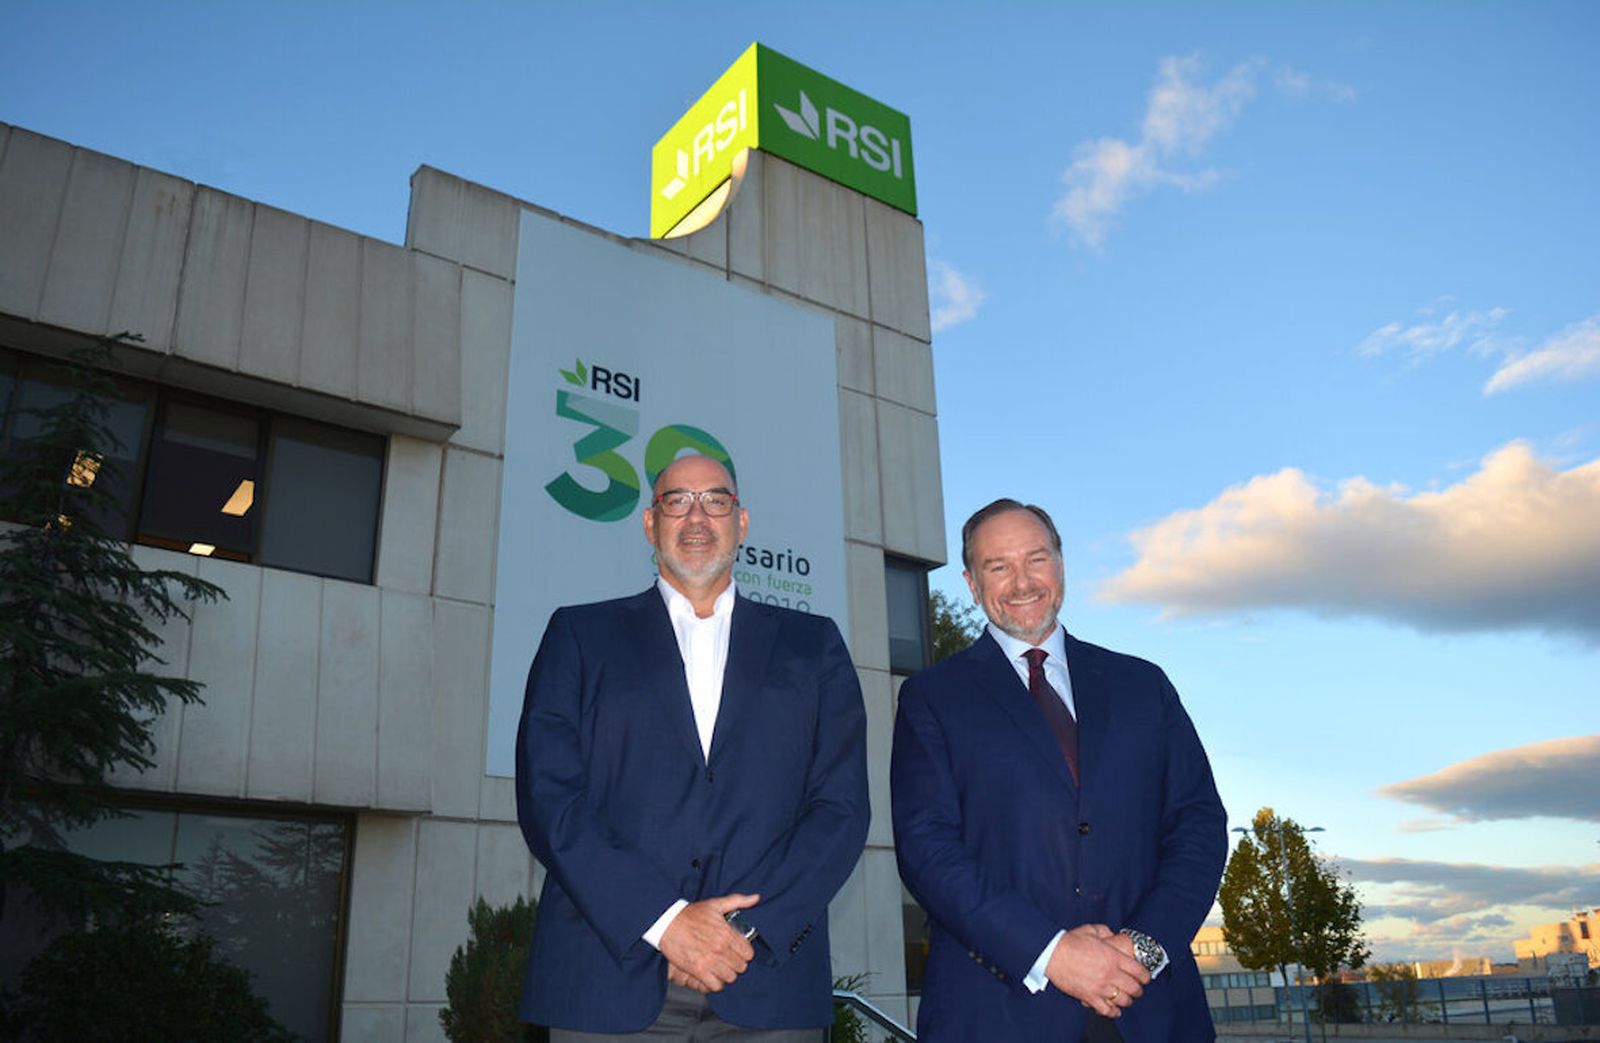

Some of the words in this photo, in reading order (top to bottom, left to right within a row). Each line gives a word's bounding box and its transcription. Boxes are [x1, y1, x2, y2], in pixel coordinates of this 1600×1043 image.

[693, 88, 747, 177] RSI
[825, 106, 903, 178] RSI
[591, 364, 640, 402] RSI
[735, 544, 810, 576] rsario
[767, 573, 812, 595] fuerza
